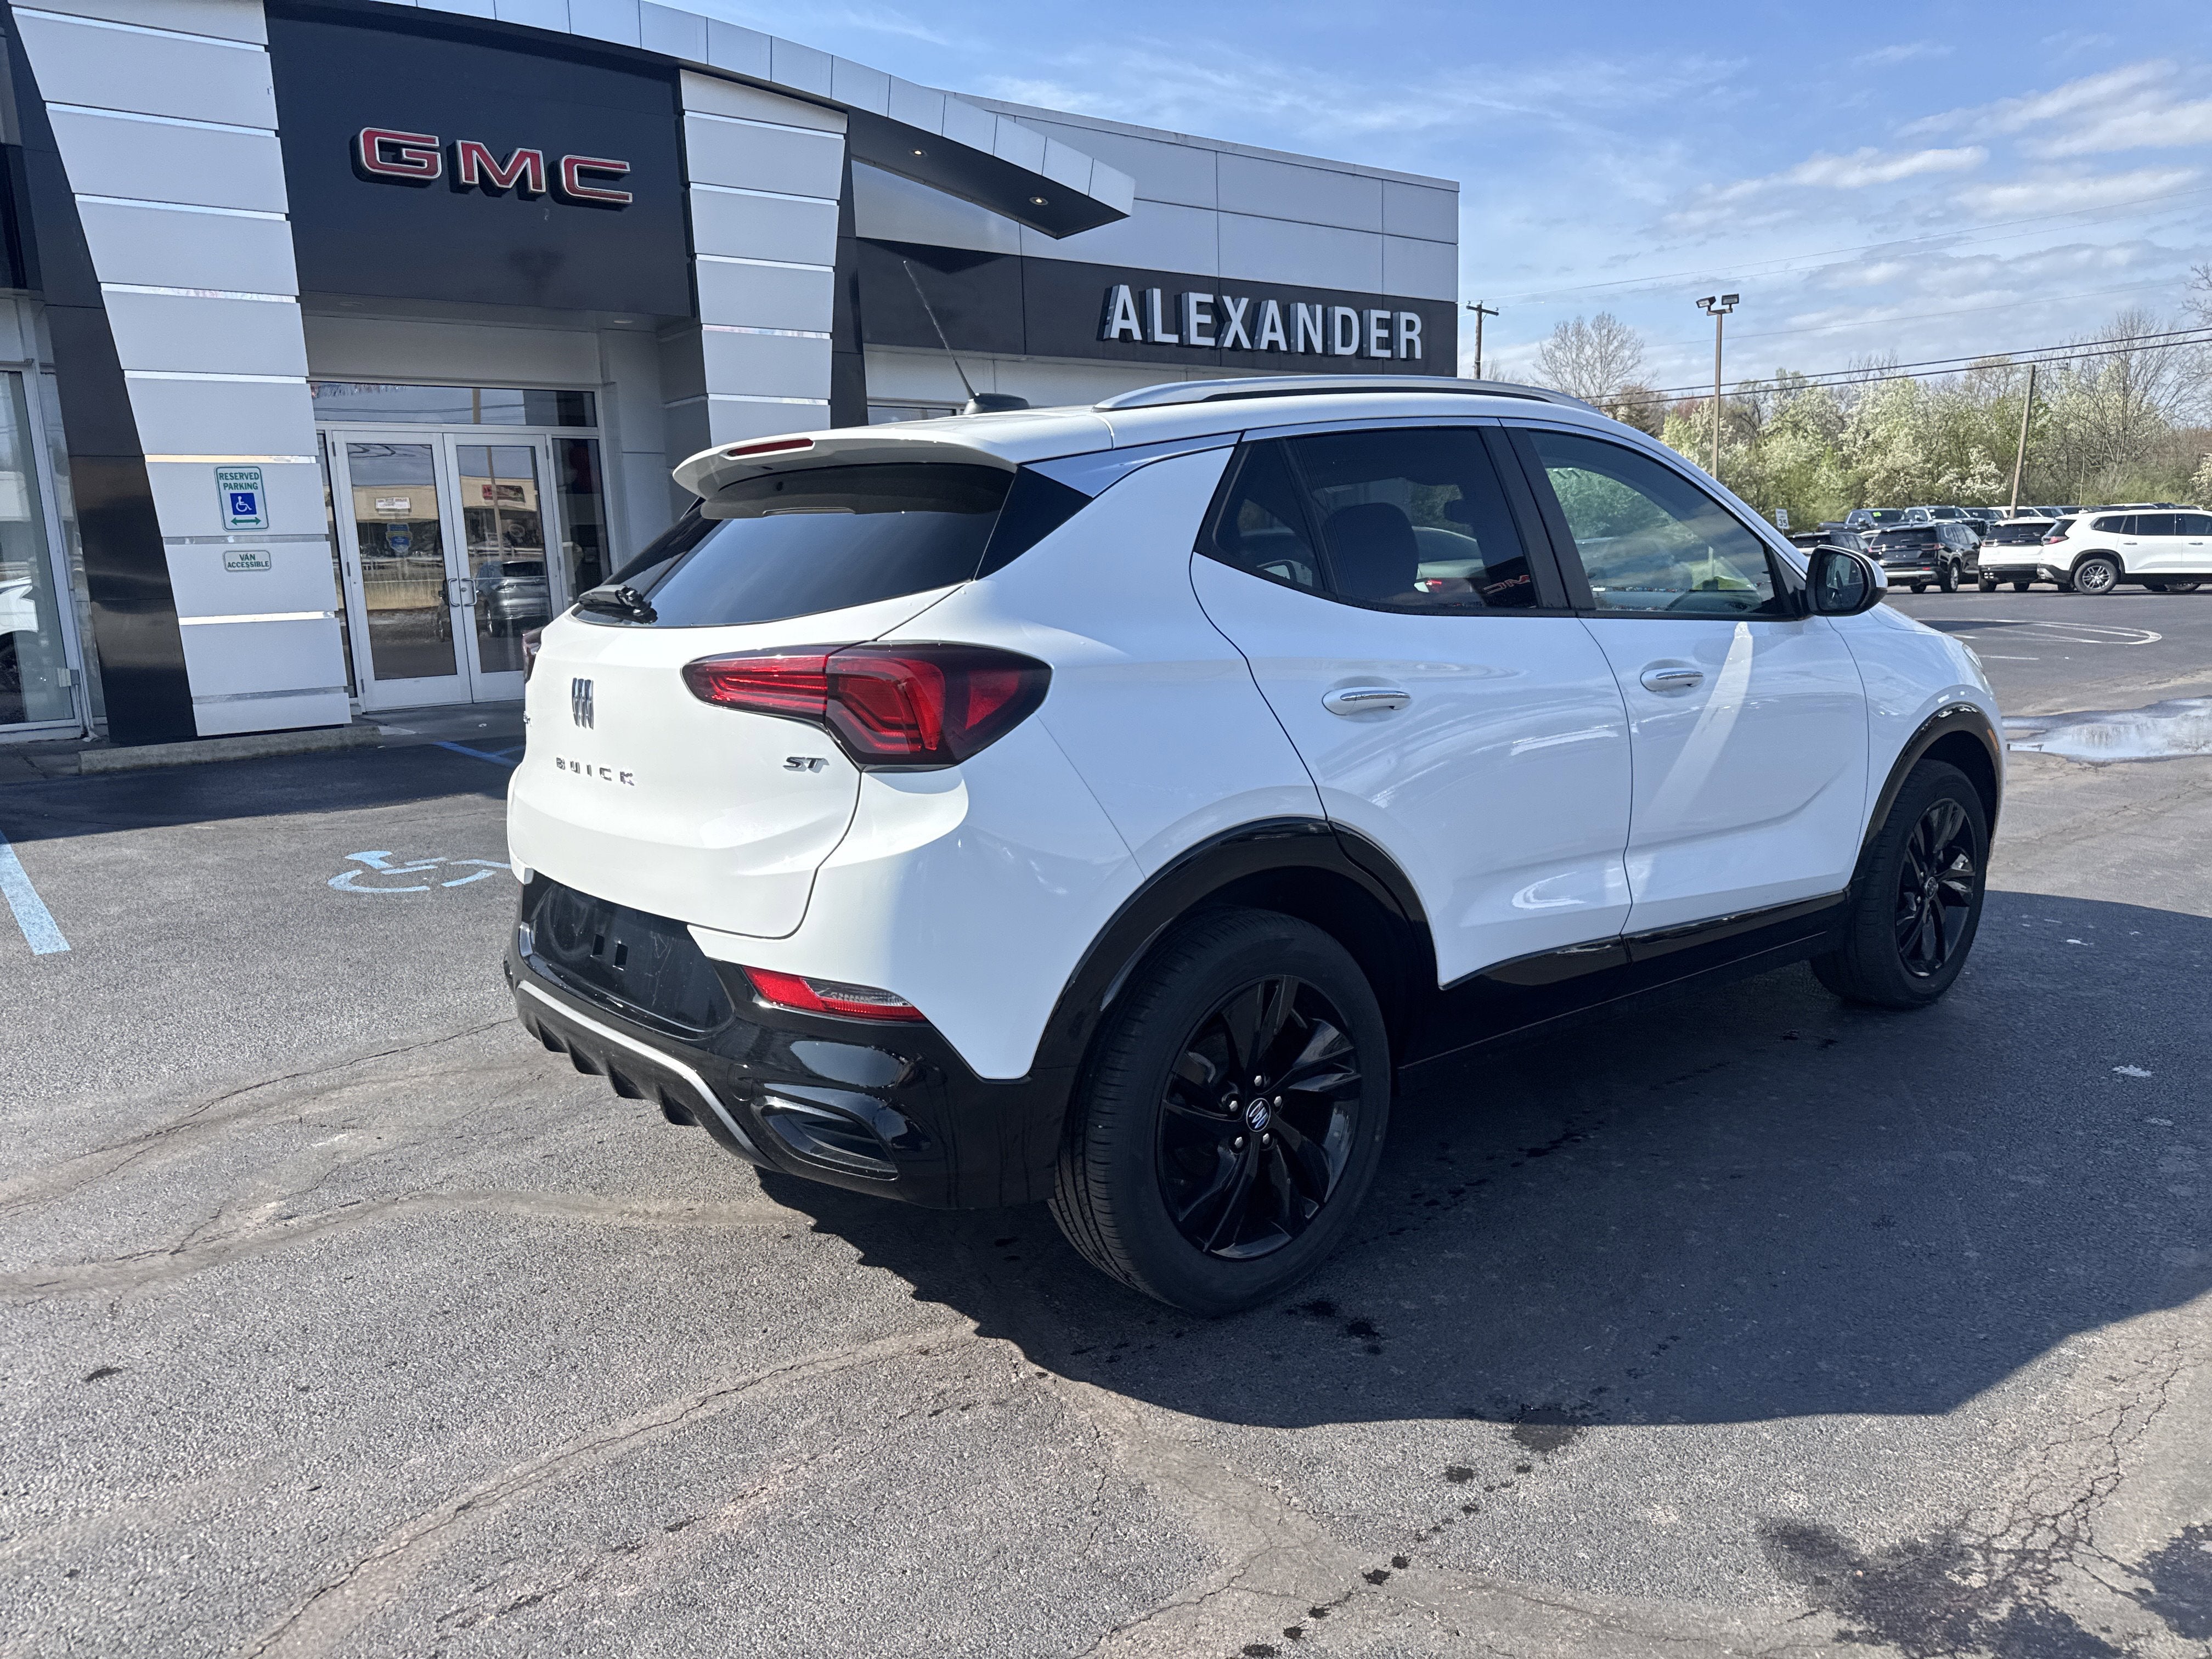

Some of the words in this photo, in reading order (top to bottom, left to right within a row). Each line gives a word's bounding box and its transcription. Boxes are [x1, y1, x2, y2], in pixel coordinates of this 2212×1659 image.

[359, 127, 633, 203] GMC
[1104, 284, 1422, 359] ALEXANDER
[219, 472, 259, 481] RESERVED
[223, 482, 259, 490] PARKING
[1779, 519, 1788, 527] 35
[783, 756, 825, 770] ST
[556, 757, 634, 786] BUICK
